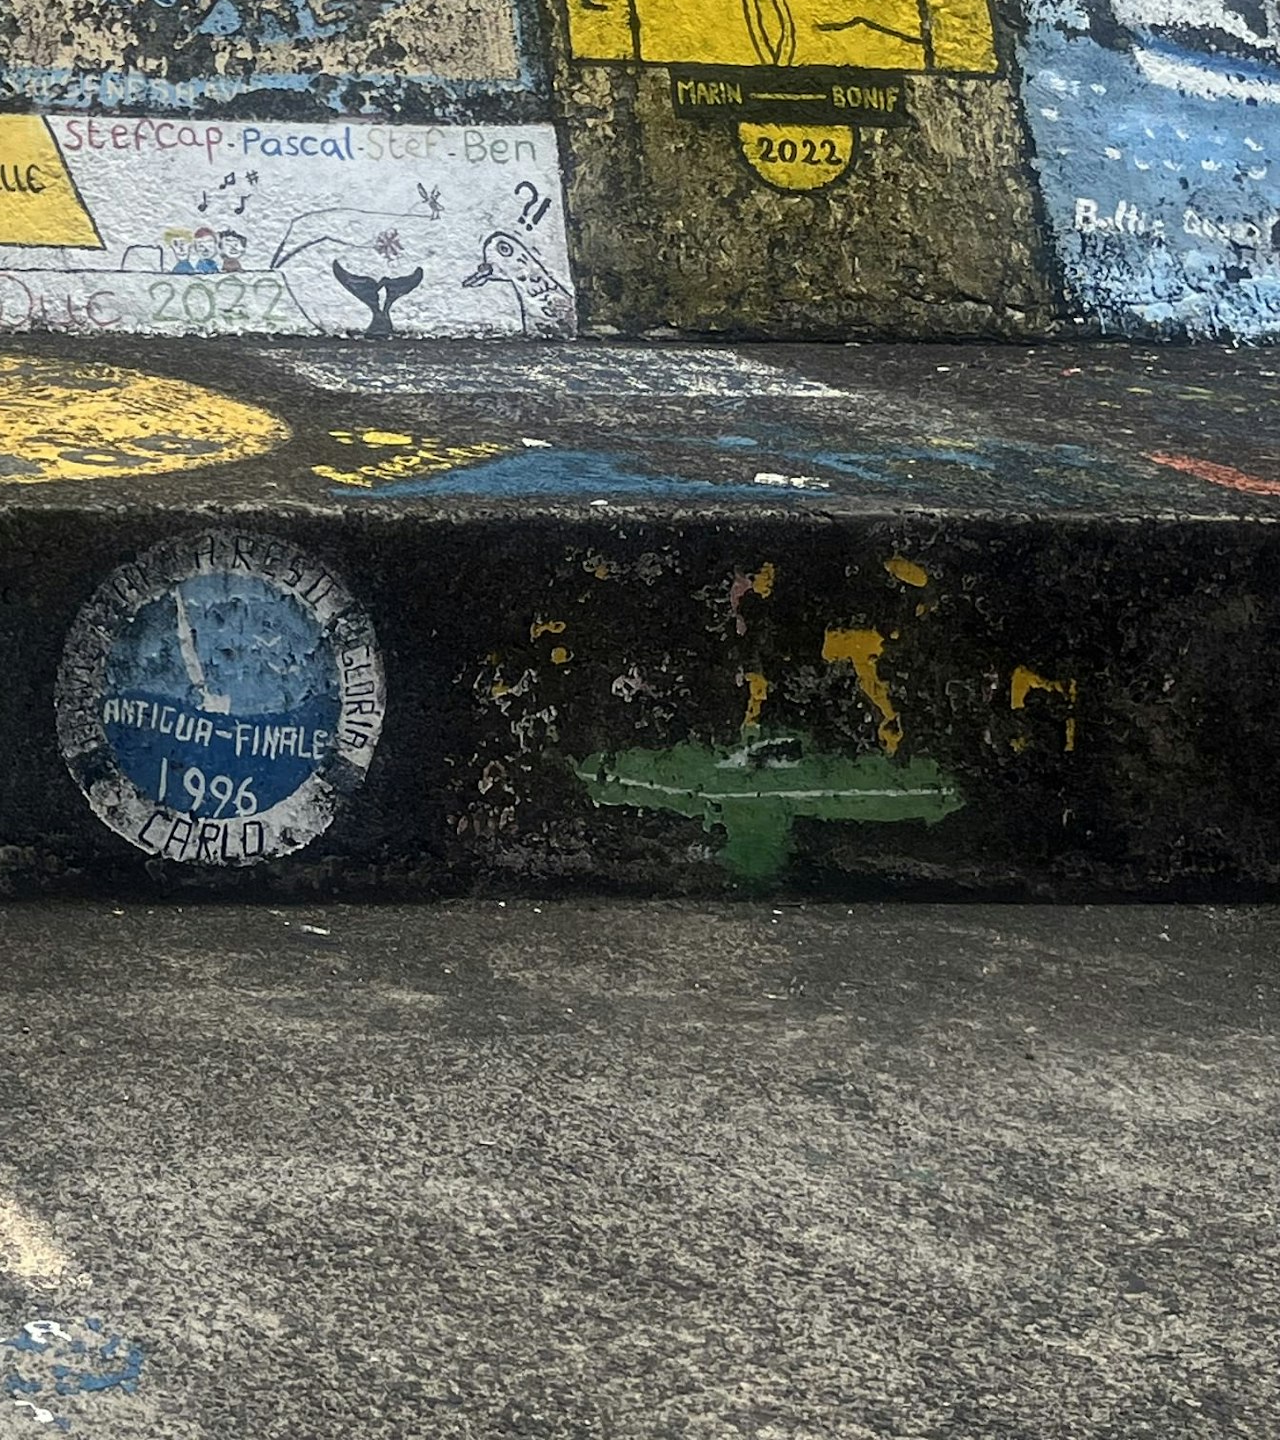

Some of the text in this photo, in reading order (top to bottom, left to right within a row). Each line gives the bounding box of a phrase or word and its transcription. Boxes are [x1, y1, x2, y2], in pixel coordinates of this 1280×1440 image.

[677, 80, 900, 111] MARIN BONIF
[757, 137, 842, 166] 2022
[148, 276, 290, 322] 2022
[158, 757, 258, 819] 1996
[138, 812, 264, 860] CARLO
